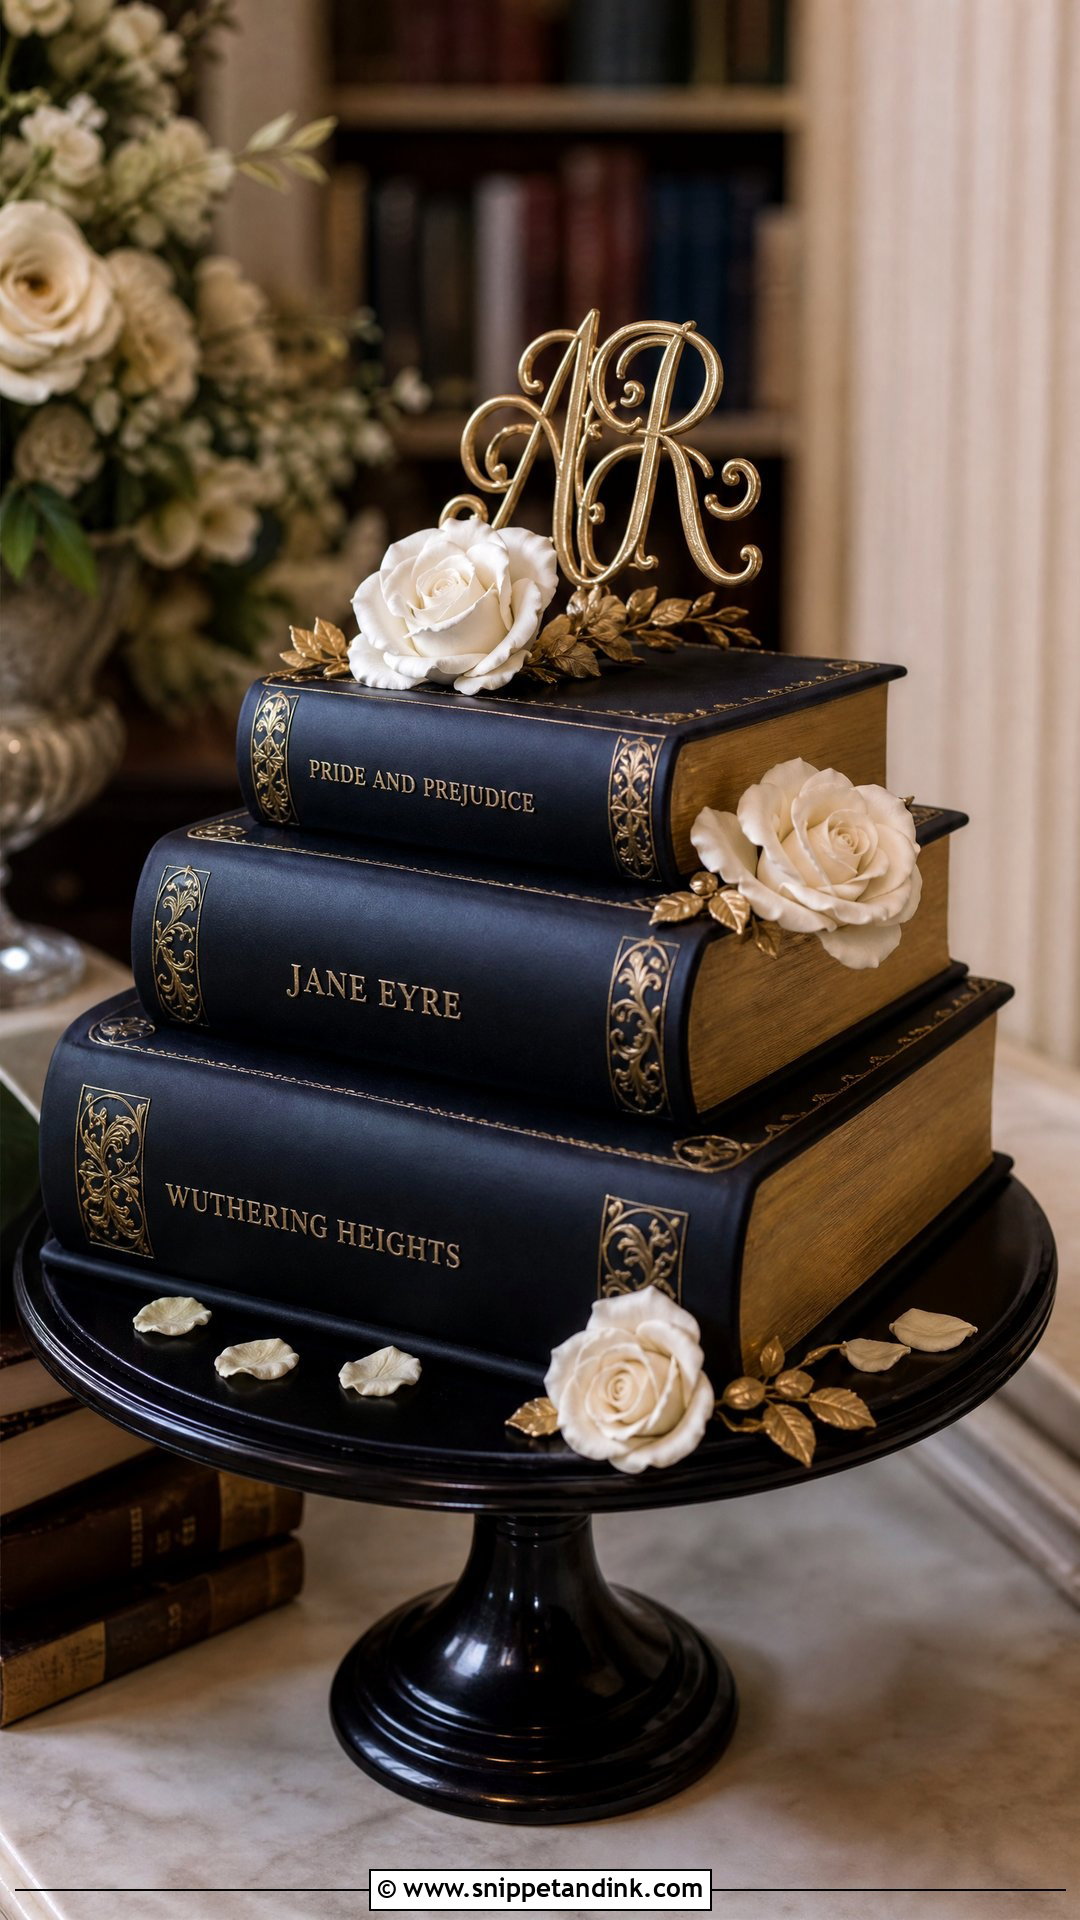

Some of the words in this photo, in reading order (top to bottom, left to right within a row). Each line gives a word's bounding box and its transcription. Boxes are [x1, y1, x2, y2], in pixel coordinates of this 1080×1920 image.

[309, 759, 366, 786] PRIDE
[372, 770, 416, 794] AND
[423, 777, 535, 813] PREJUDICE
[286, 963, 368, 1003] JANE
[378, 979, 462, 1020] EYRE
[165, 1183, 328, 1239] WUTHERING
[337, 1219, 461, 1269] HEIGHTS
